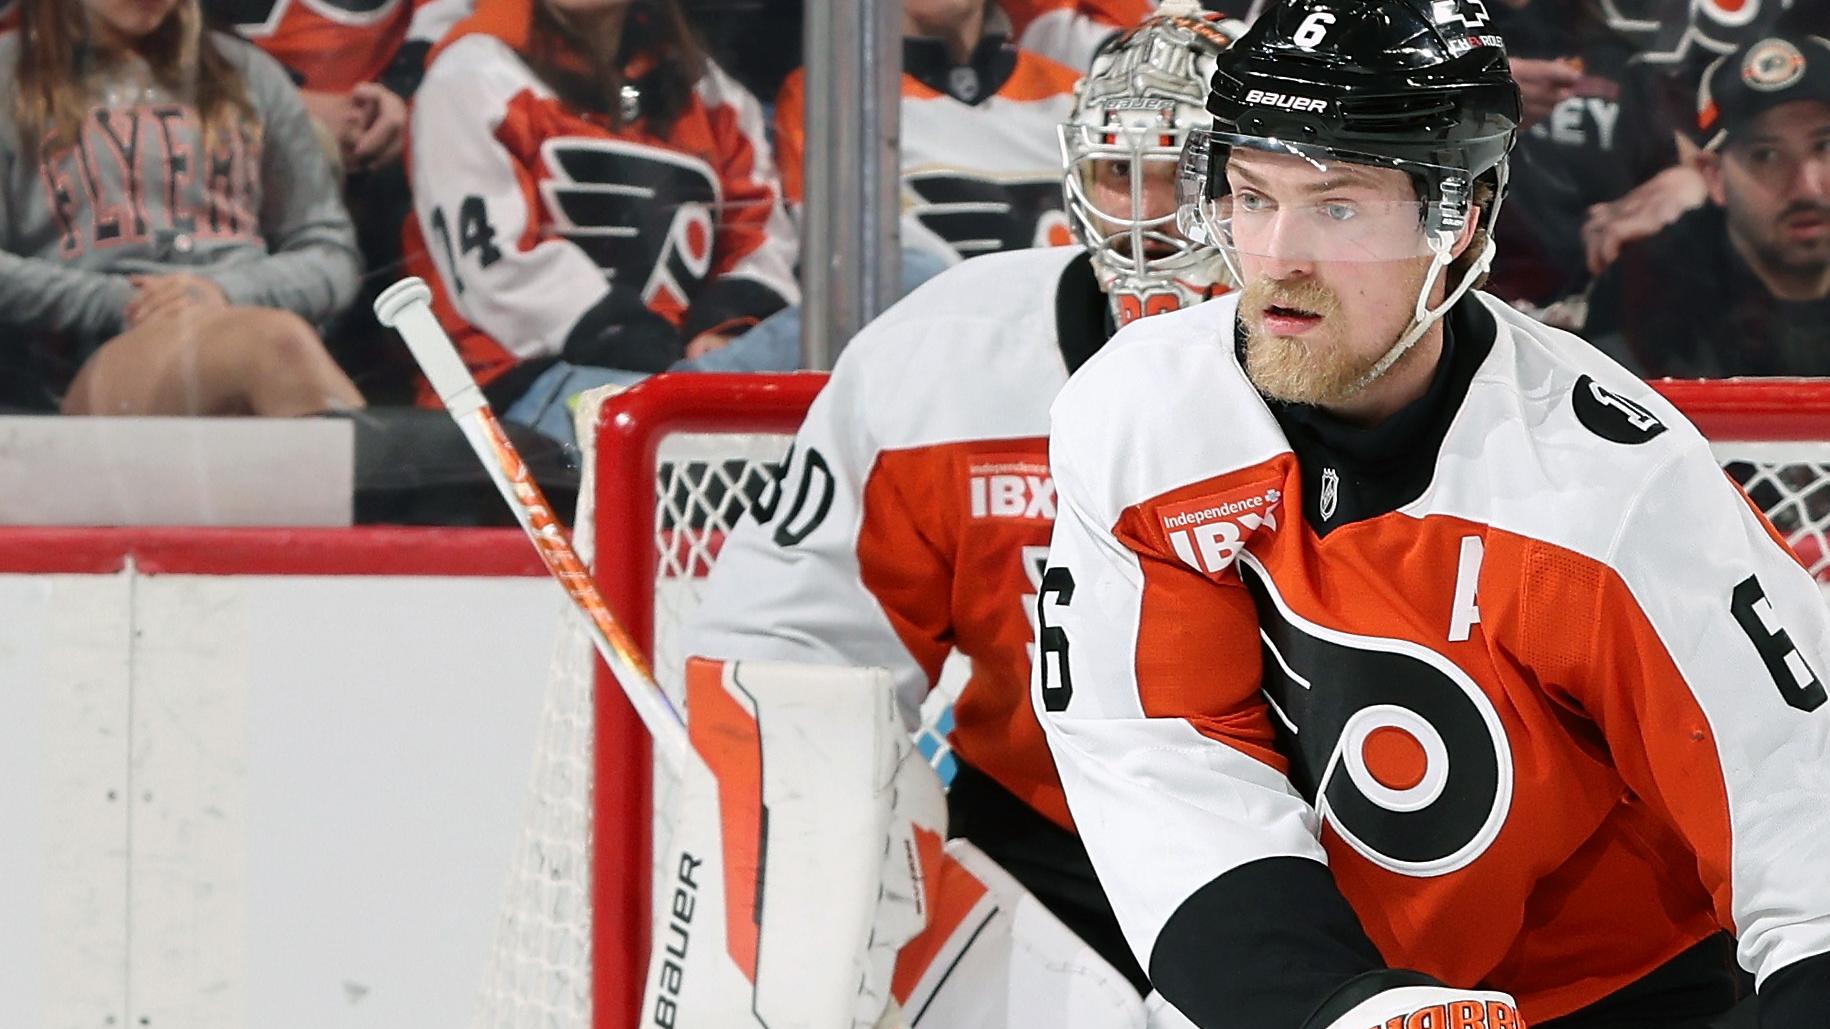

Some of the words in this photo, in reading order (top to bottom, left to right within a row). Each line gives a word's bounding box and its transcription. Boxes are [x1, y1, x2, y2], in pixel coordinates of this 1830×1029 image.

[1293, 12, 1336, 52] 6
[1245, 90, 1328, 114] BAUER
[430, 194, 502, 295] 14
[970, 475, 1056, 519] IBX
[1163, 494, 1263, 529] Independence
[1037, 567, 1076, 712] 6
[1730, 573, 1828, 713] 6
